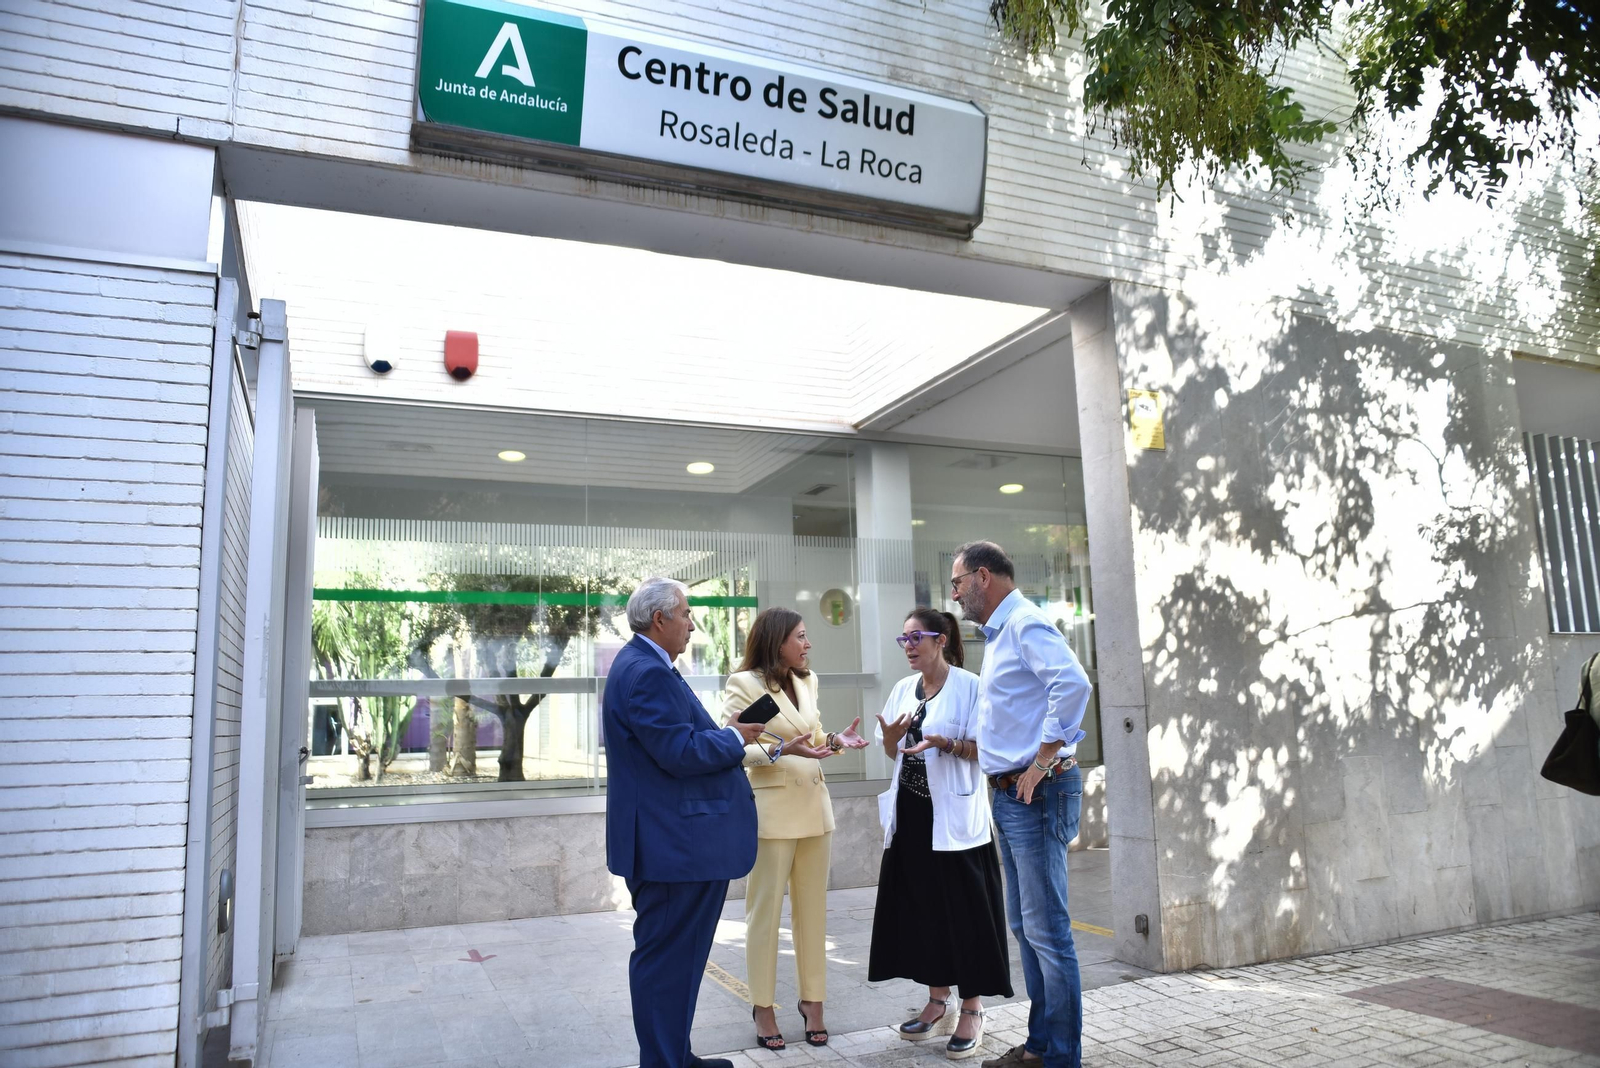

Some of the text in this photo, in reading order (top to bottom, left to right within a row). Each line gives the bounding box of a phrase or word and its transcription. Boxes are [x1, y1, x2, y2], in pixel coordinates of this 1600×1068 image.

[435, 78, 568, 113] Junta de Andalucía
[617, 45, 916, 137] Centro de Salud
[659, 109, 794, 161] Rosaleda
[820, 140, 850, 171] La
[859, 148, 922, 185] Roca
